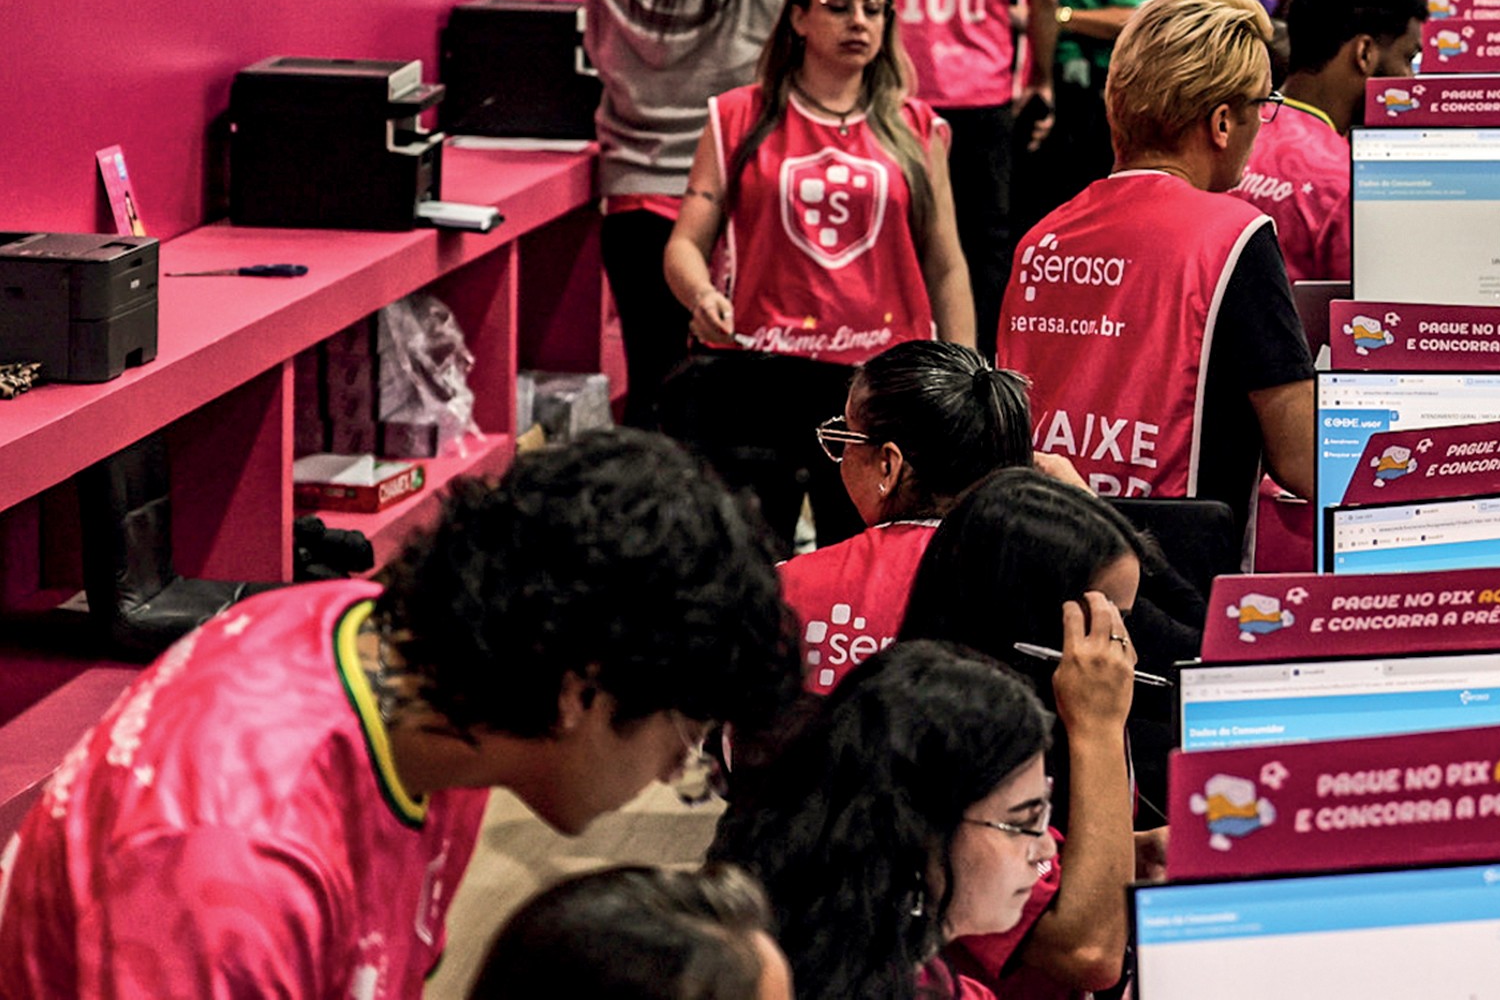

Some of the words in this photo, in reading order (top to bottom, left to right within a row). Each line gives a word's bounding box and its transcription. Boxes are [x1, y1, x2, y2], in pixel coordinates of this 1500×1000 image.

[1442, 90, 1484, 99] PAGUE
[1431, 103, 1438, 112] E
[827, 190, 850, 225] S
[1030, 253, 1127, 287] serasa
[1418, 322, 1470, 334] PAGUE
[1471, 324, 1494, 335] NO
[1406, 338, 1417, 349] E
[1418, 339, 1500, 352] CONCORRA
[1034, 409, 1160, 469] AIXE
[1445, 441, 1498, 456] PAGUE
[1425, 464, 1439, 477] E
[1331, 594, 1401, 610] PAGUE
[1403, 593, 1435, 607] NO
[1437, 590, 1475, 605] PIX
[1309, 618, 1325, 632] E
[1327, 613, 1439, 631] CONCORRA
[1441, 612, 1458, 625] A
[1316, 769, 1401, 796] PAGUE
[1404, 765, 1443, 789] NO
[1445, 761, 1491, 785] PIX
[1294, 809, 1313, 832] E
[1315, 798, 1452, 830] CONCORRA
[1455, 796, 1476, 819] A
